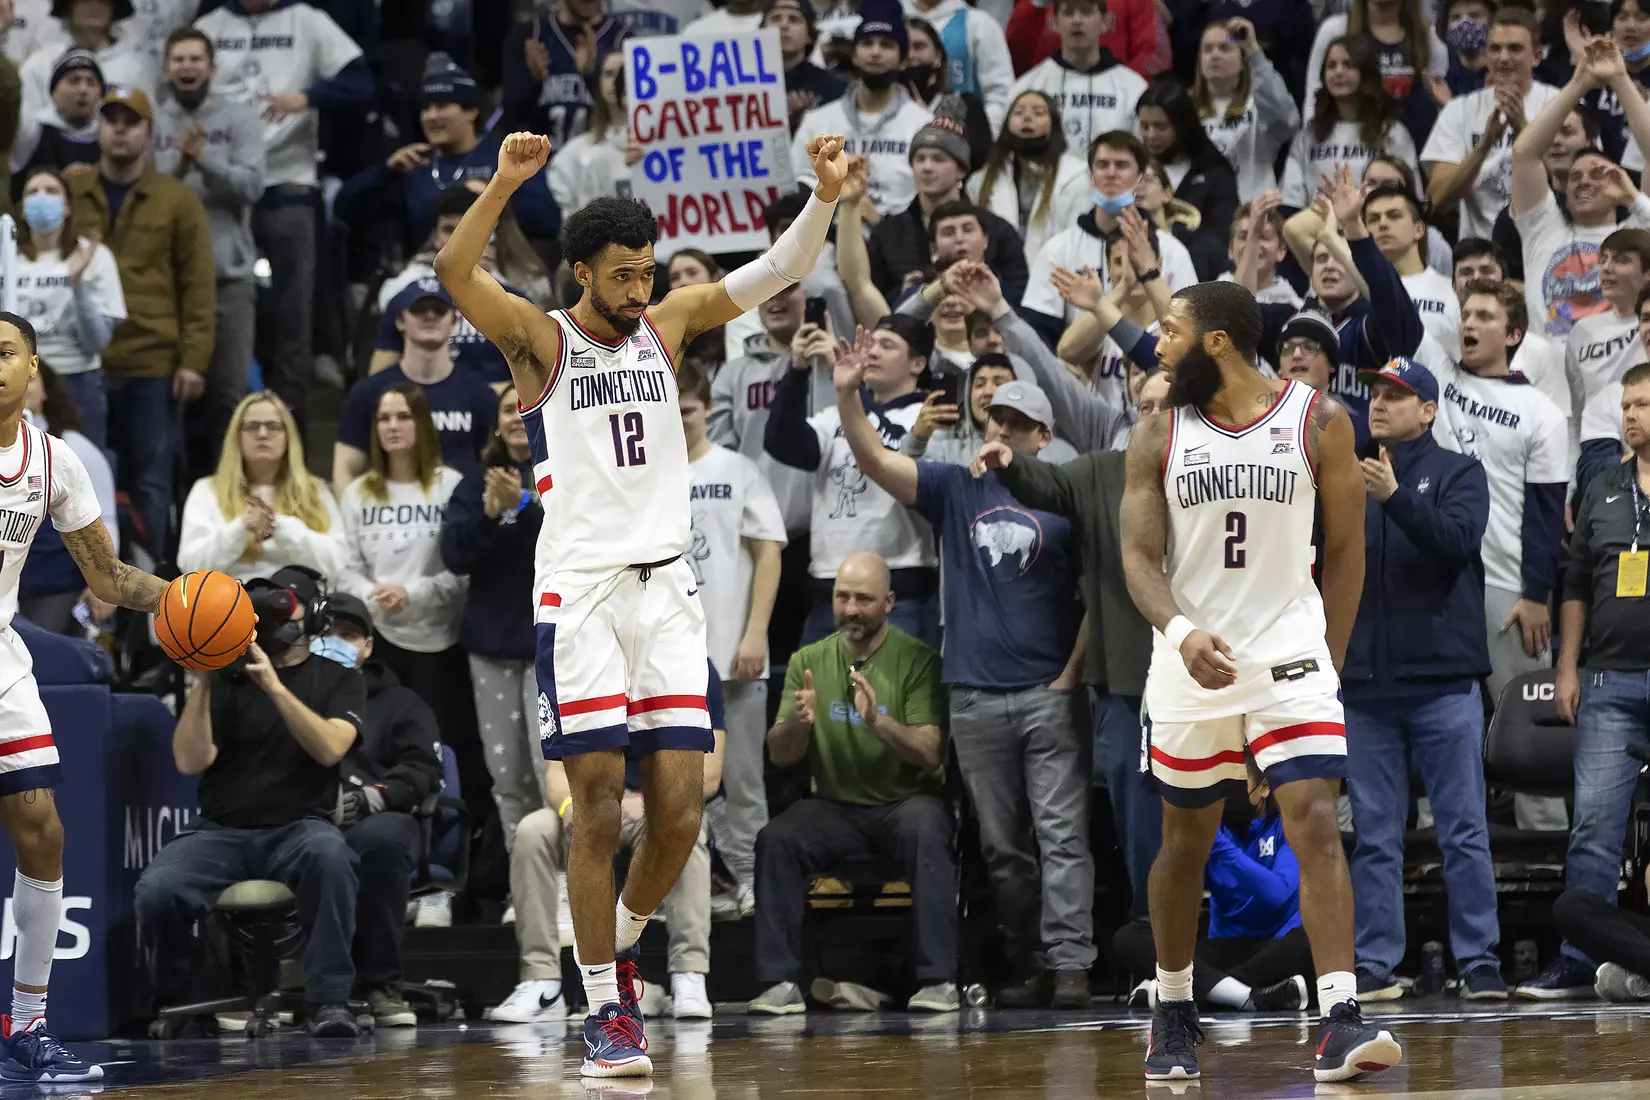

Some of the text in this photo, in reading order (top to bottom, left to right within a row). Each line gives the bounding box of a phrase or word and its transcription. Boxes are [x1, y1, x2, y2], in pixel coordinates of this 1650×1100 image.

[633, 38, 777, 101] B-BALL
[634, 91, 784, 145] CAPITAL
[644, 140, 770, 183] OF THE
[1413, 298, 1445, 314] VIER
[570, 369, 668, 411] CONNECTICUT
[1443, 382, 1521, 430] BEAT XAVIER
[609, 411, 647, 467] 12
[1176, 464, 1299, 509] CONNECTICUT
[1224, 511, 1247, 569] 2
[1523, 682, 1555, 701] UC
